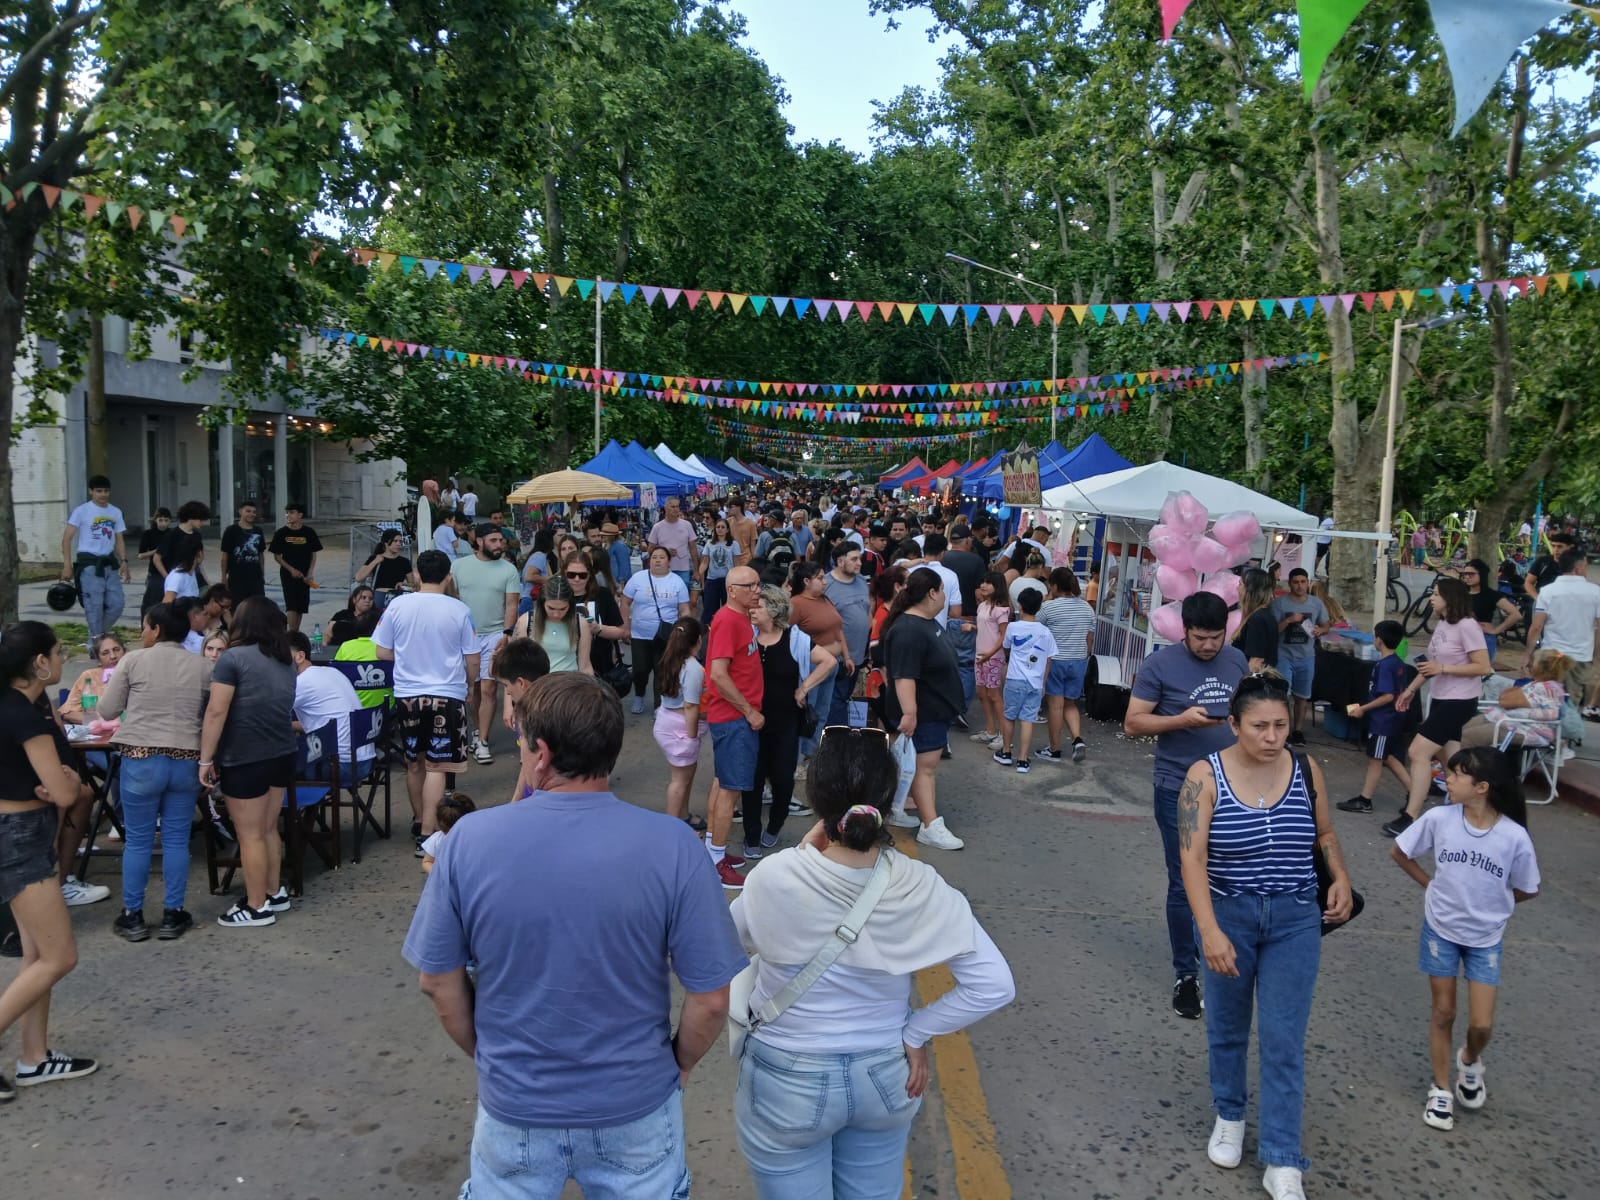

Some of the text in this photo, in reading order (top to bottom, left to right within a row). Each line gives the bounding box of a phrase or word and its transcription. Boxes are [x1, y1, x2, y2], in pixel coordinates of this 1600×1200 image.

[401, 696, 449, 712] YPF
[1438, 849, 1504, 878] Good Vibes
